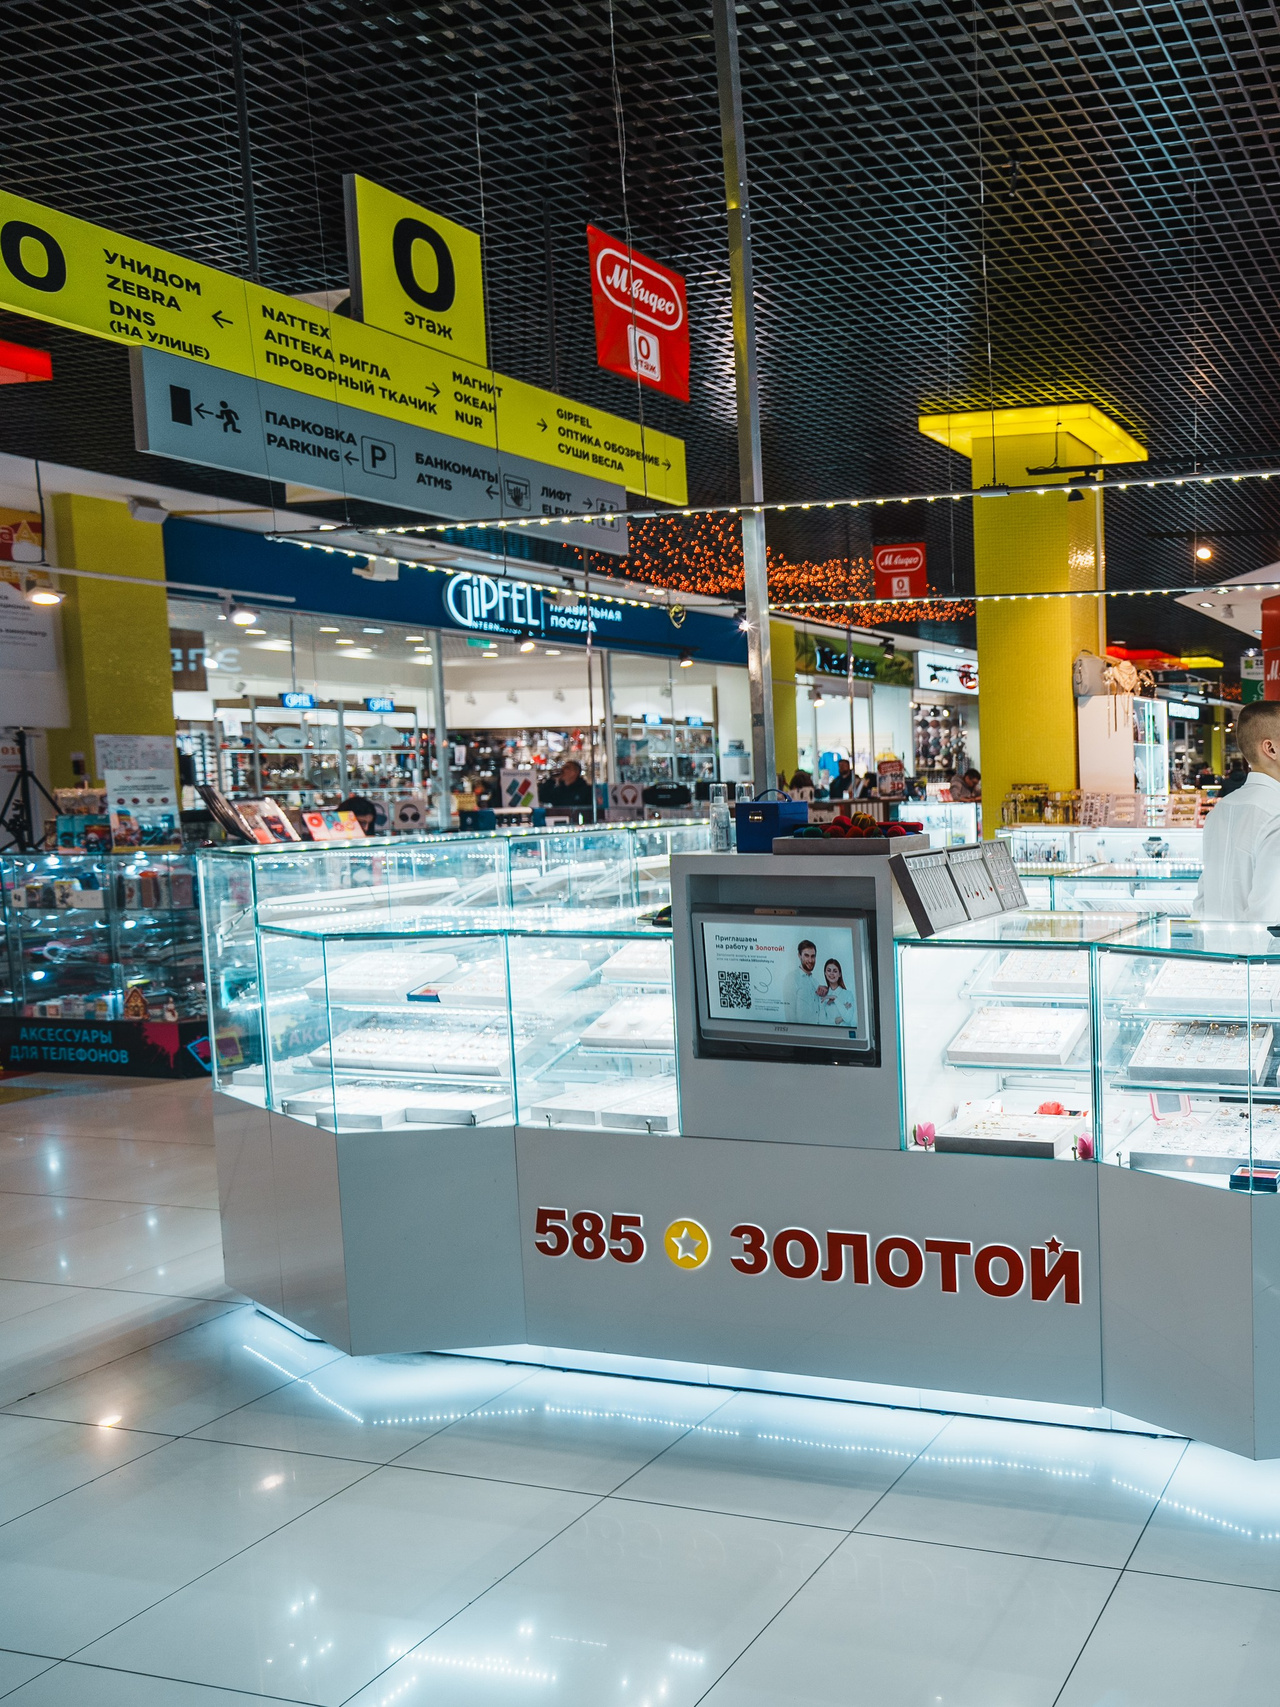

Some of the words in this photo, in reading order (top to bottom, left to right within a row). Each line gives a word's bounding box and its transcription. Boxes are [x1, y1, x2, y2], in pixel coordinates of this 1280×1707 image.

[103, 248, 202, 296] УНИДОМ
[106, 274, 182, 312] ZEBRA
[108, 300, 156, 327] DNS
[261, 304, 330, 340] NATTEX
[403, 311, 453, 340] этаж
[109, 320, 144, 340] (НА
[147, 331, 210, 361] УЛИЦЕ)
[263, 329, 335, 363] АПТЕКА
[339, 353, 391, 381] РИГЛА
[265, 350, 375, 396] ПРОВОРНЫЙ
[378, 387, 438, 416] ТКАЧИК
[452, 371, 503, 398] МАГНИТ
[453, 392, 497, 413] ОКЕАН
[265, 410, 357, 446] ПАРКОВКА
[455, 410, 483, 429] NUR
[556, 408, 593, 429] GIPFEL
[266, 432, 340, 462] PARKING
[370, 444, 387, 468] P
[557, 426, 602, 449] ОПТИКА
[603, 441, 660, 467] ОБОЗРЕНИЕ
[557, 443, 590, 461] СУШИ
[591, 454, 624, 472] ВЕСЛА
[415, 452, 498, 484] БАНКОМАТЫ
[416, 472, 453, 492] ATMS
[541, 486, 572, 503] ЛИФТ
[550, 615, 597, 632] ПОСУДА
[725, 943, 748, 951] работу
[755, 944, 785, 952] Золотой!
[20, 1027, 112, 1044] АКСЕССУАРЫ
[10, 1046, 39, 1061] ДЛЯ
[42, 1046, 129, 1064] ТЕЛЕФОНОВ
[534, 1206, 645, 1264] 585
[729, 1223, 1082, 1305] ЗОЛОТОЙ
